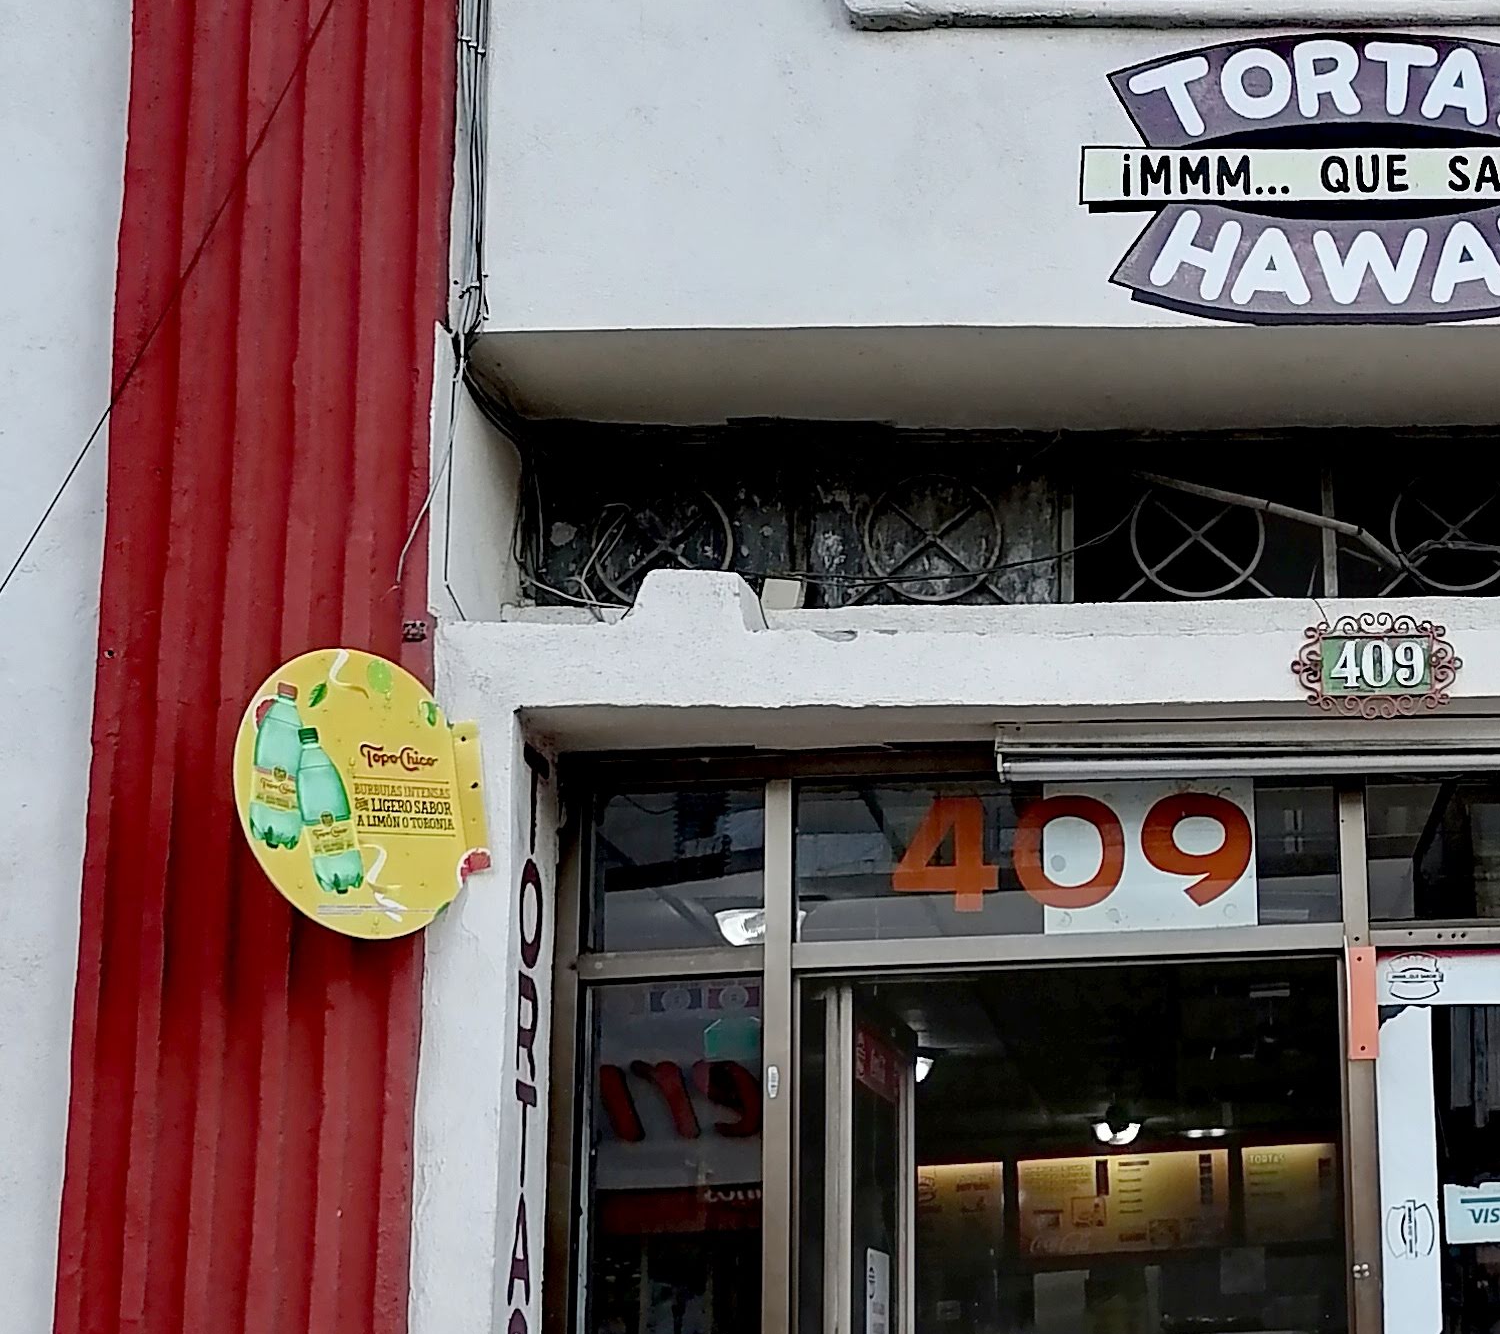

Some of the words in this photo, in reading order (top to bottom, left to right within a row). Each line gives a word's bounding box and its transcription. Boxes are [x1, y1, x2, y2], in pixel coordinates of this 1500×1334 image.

[1320, 155, 1410, 194] QUE
[1329, 640, 1426, 690] 409
[360, 744, 400, 768] Topo
[400, 747, 438, 771] Chico
[404, 786, 450, 799] INTENSAS
[371, 798, 413, 813] LIGERO
[414, 800, 452, 815] SABOR
[357, 815, 366, 826] A
[367, 814, 400, 827] LIMÓN
[402, 816, 409, 828] O
[410, 817, 455, 830] TORONJA
[892, 792, 1254, 913] 409
